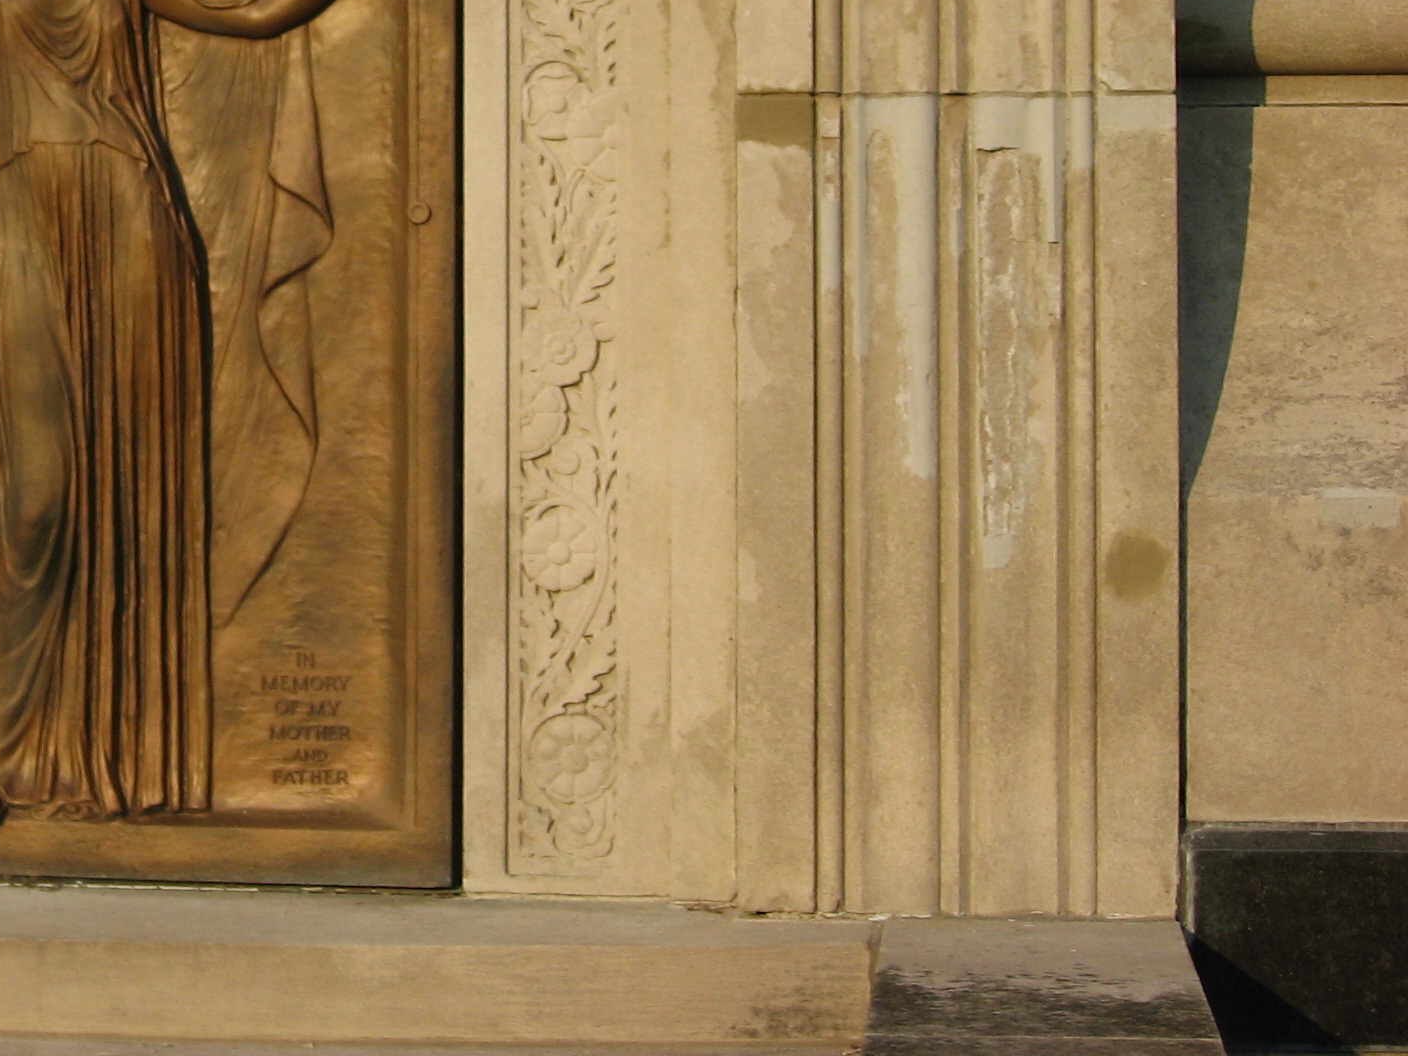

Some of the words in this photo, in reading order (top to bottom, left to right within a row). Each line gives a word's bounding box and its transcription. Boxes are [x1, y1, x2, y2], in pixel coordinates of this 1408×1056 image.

[296, 652, 316, 668] IN
[261, 675, 352, 691] MEMORY
[275, 700, 299, 716] OF
[308, 700, 342, 716] MY
[269, 725, 351, 740] MOTHER
[293, 748, 328, 762] AND
[272, 769, 349, 785] FATHER
